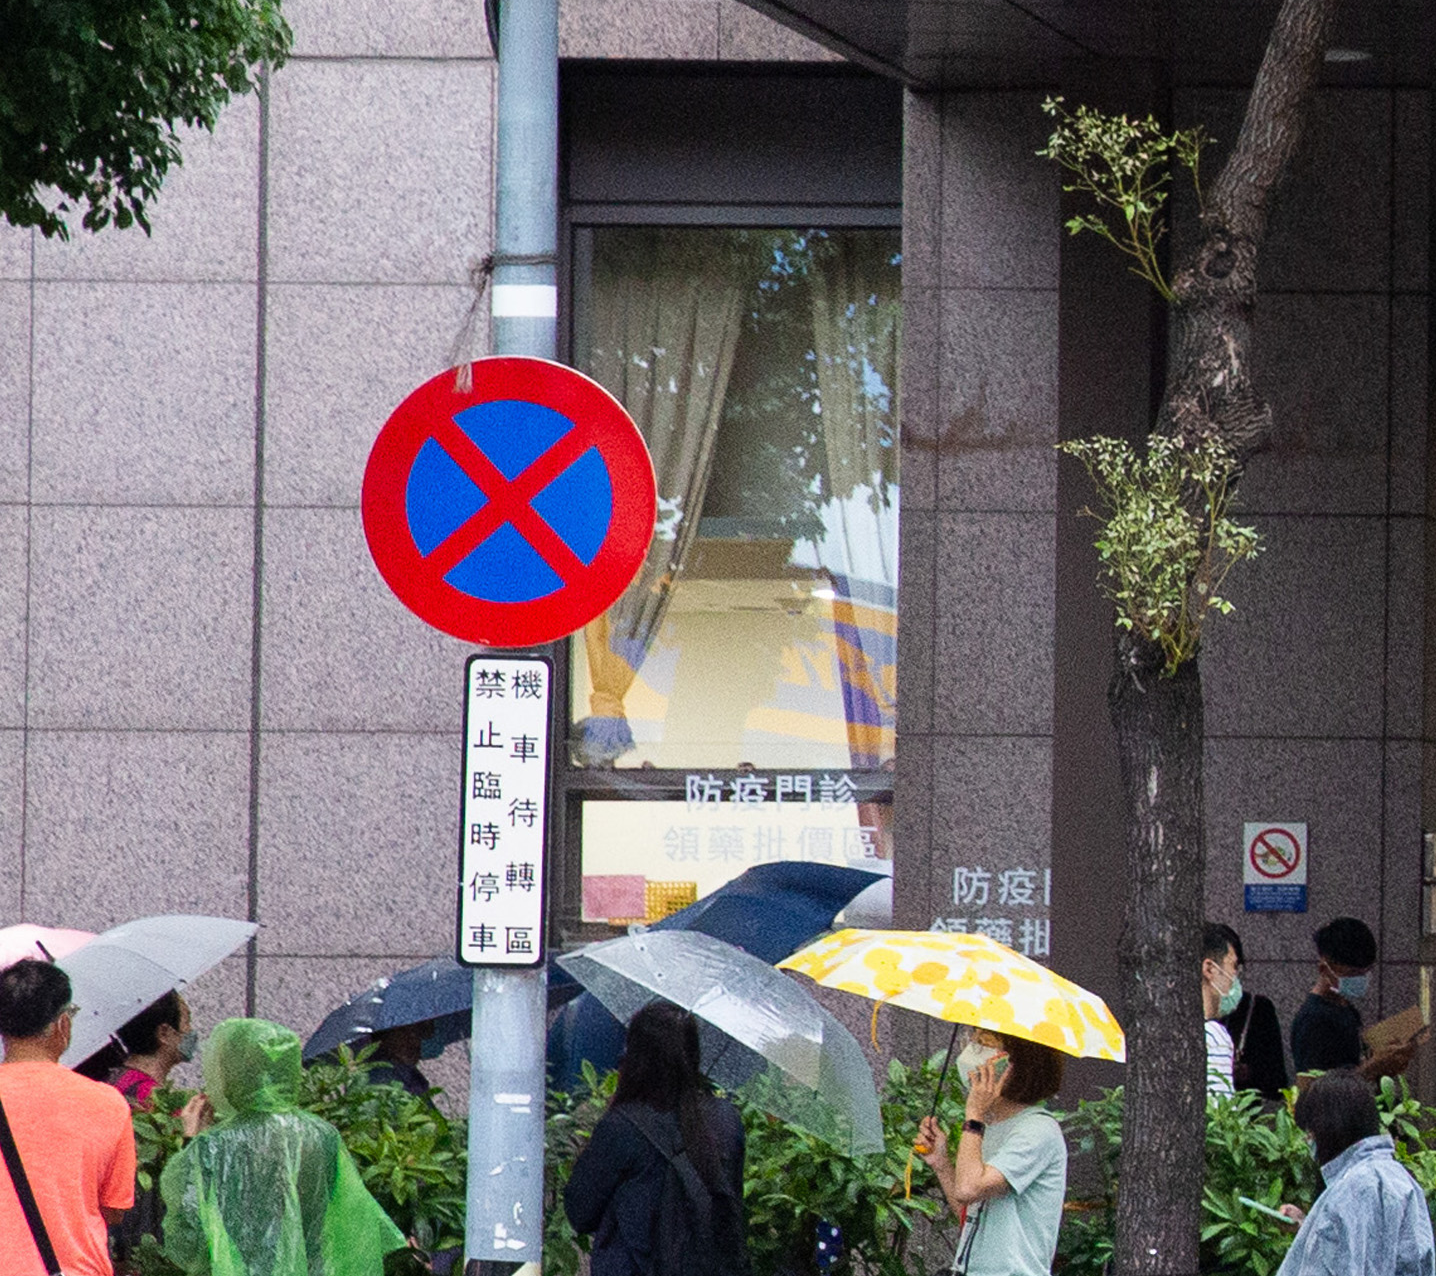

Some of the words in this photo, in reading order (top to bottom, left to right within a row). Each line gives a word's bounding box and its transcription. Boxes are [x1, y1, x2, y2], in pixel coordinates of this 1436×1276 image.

[468, 668, 507, 953] 禁止臨時停車
[504, 669, 543, 955] 機車待轉區
[685, 774, 858, 812] 防疫門診
[663, 825, 878, 862] 領藥批價區
[953, 866, 1051, 905] 防疫
